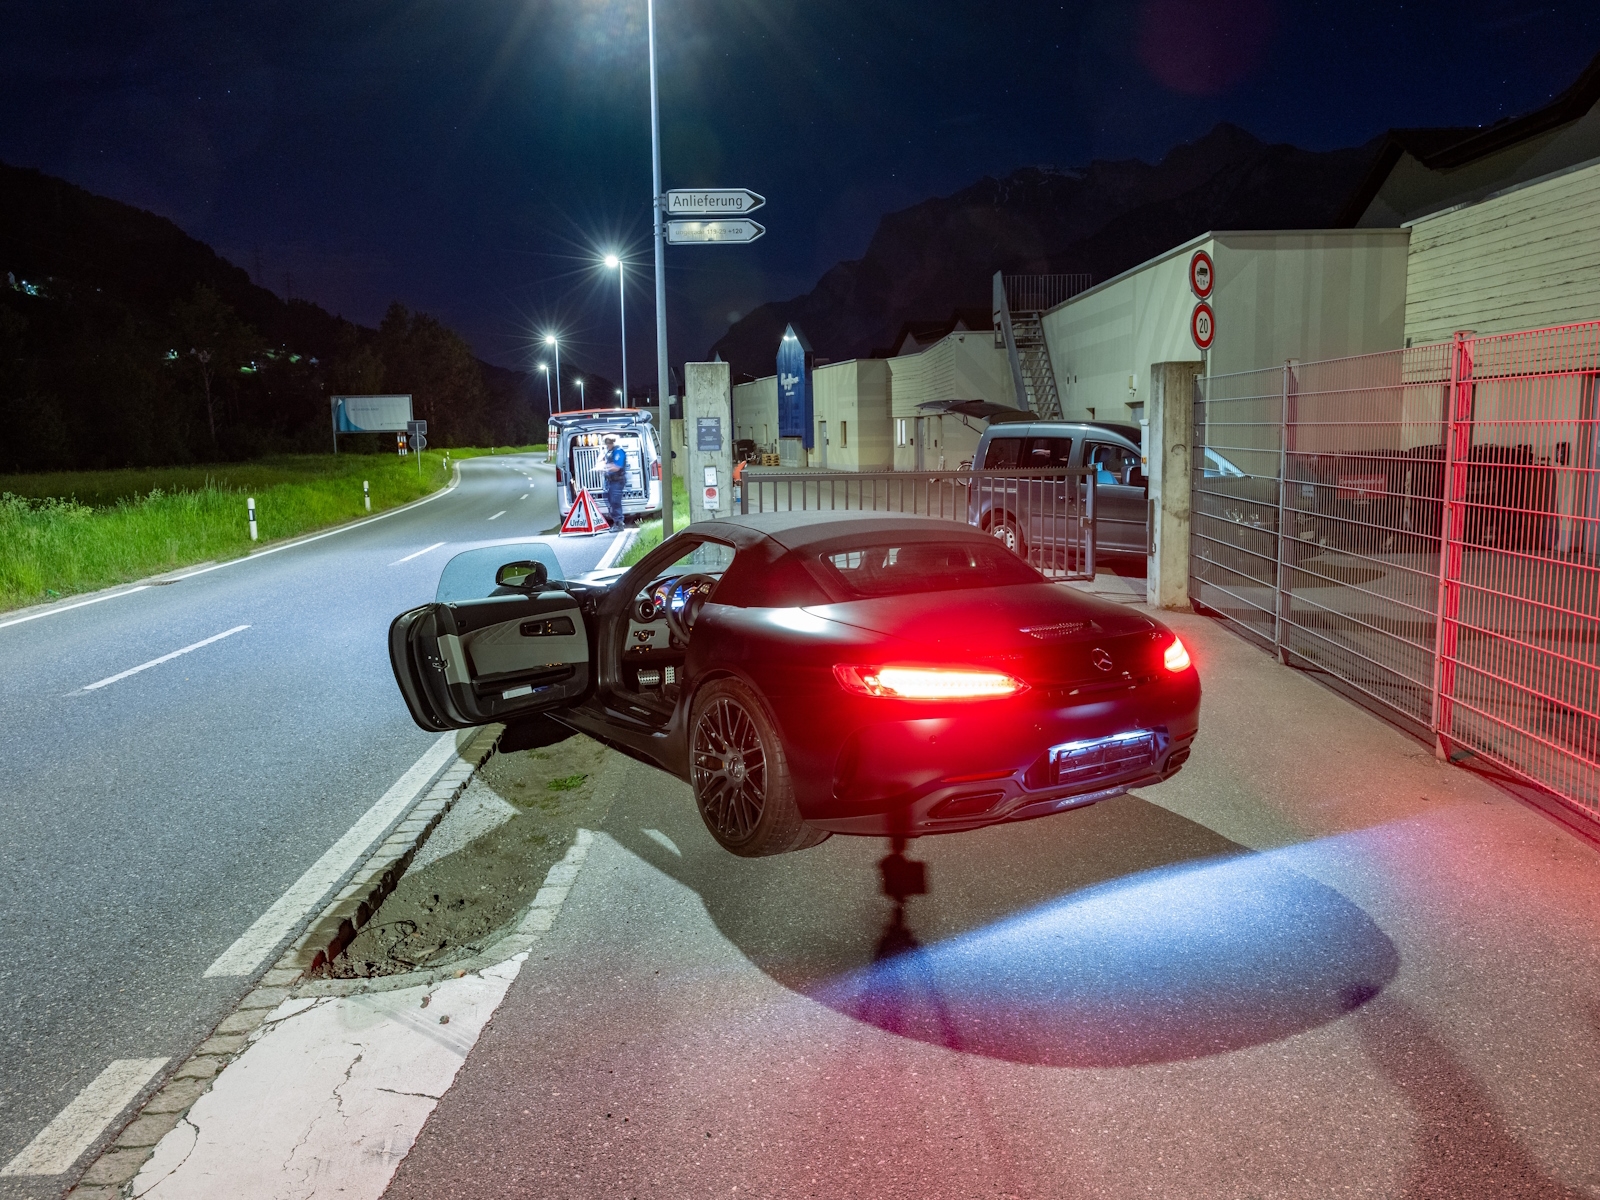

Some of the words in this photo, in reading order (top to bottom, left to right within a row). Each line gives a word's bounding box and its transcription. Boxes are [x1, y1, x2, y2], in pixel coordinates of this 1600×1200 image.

[673, 195, 743, 209] Anlieferung
[1199, 318, 1209, 334] 20
[570, 519, 587, 527] Unfall
